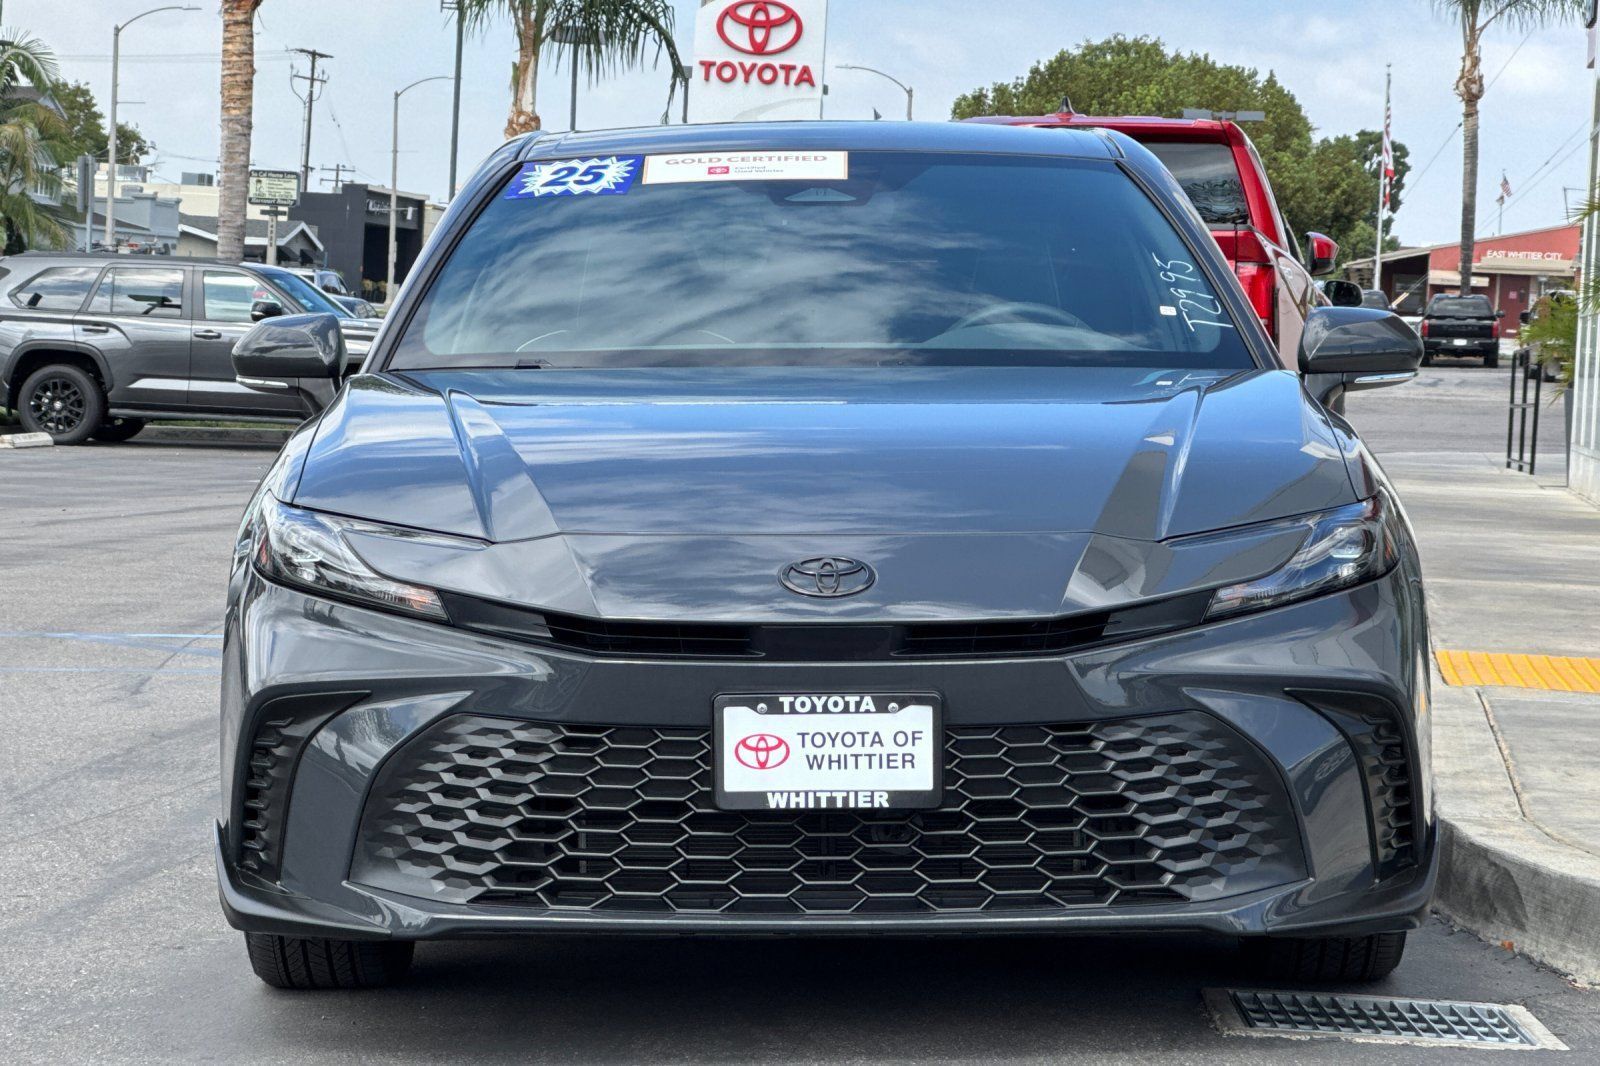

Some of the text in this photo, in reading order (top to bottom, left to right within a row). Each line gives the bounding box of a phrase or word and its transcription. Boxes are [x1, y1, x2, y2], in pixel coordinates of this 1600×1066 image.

[699, 60, 815, 87] TOYOTA
[665, 155, 828, 165] GOLD CERTIFIED
[540, 165, 609, 187] 25
[1487, 250, 1562, 260] EAST WHITTIER CITY
[779, 696, 876, 713] TOYOTA
[797, 730, 924, 748] TOYOTA OF
[806, 753, 916, 770] WHITTIER
[767, 791, 890, 809] WHITTIER
